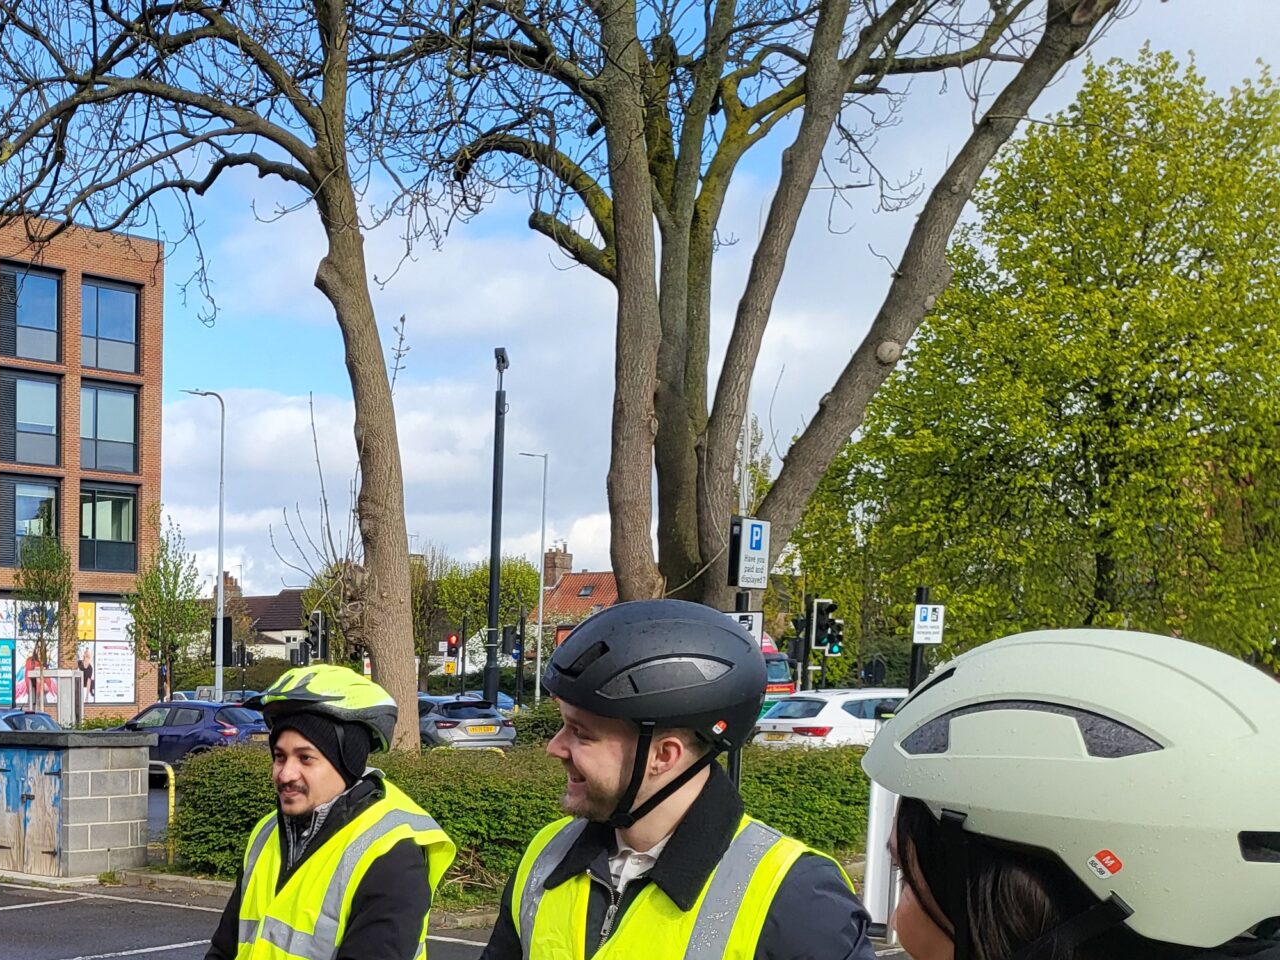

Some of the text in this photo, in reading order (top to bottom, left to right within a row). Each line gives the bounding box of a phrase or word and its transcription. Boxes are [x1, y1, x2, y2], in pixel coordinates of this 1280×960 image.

[744, 554, 765, 565] Have you
[744, 564, 754, 573] paid
[1102, 855, 1115, 867] M
